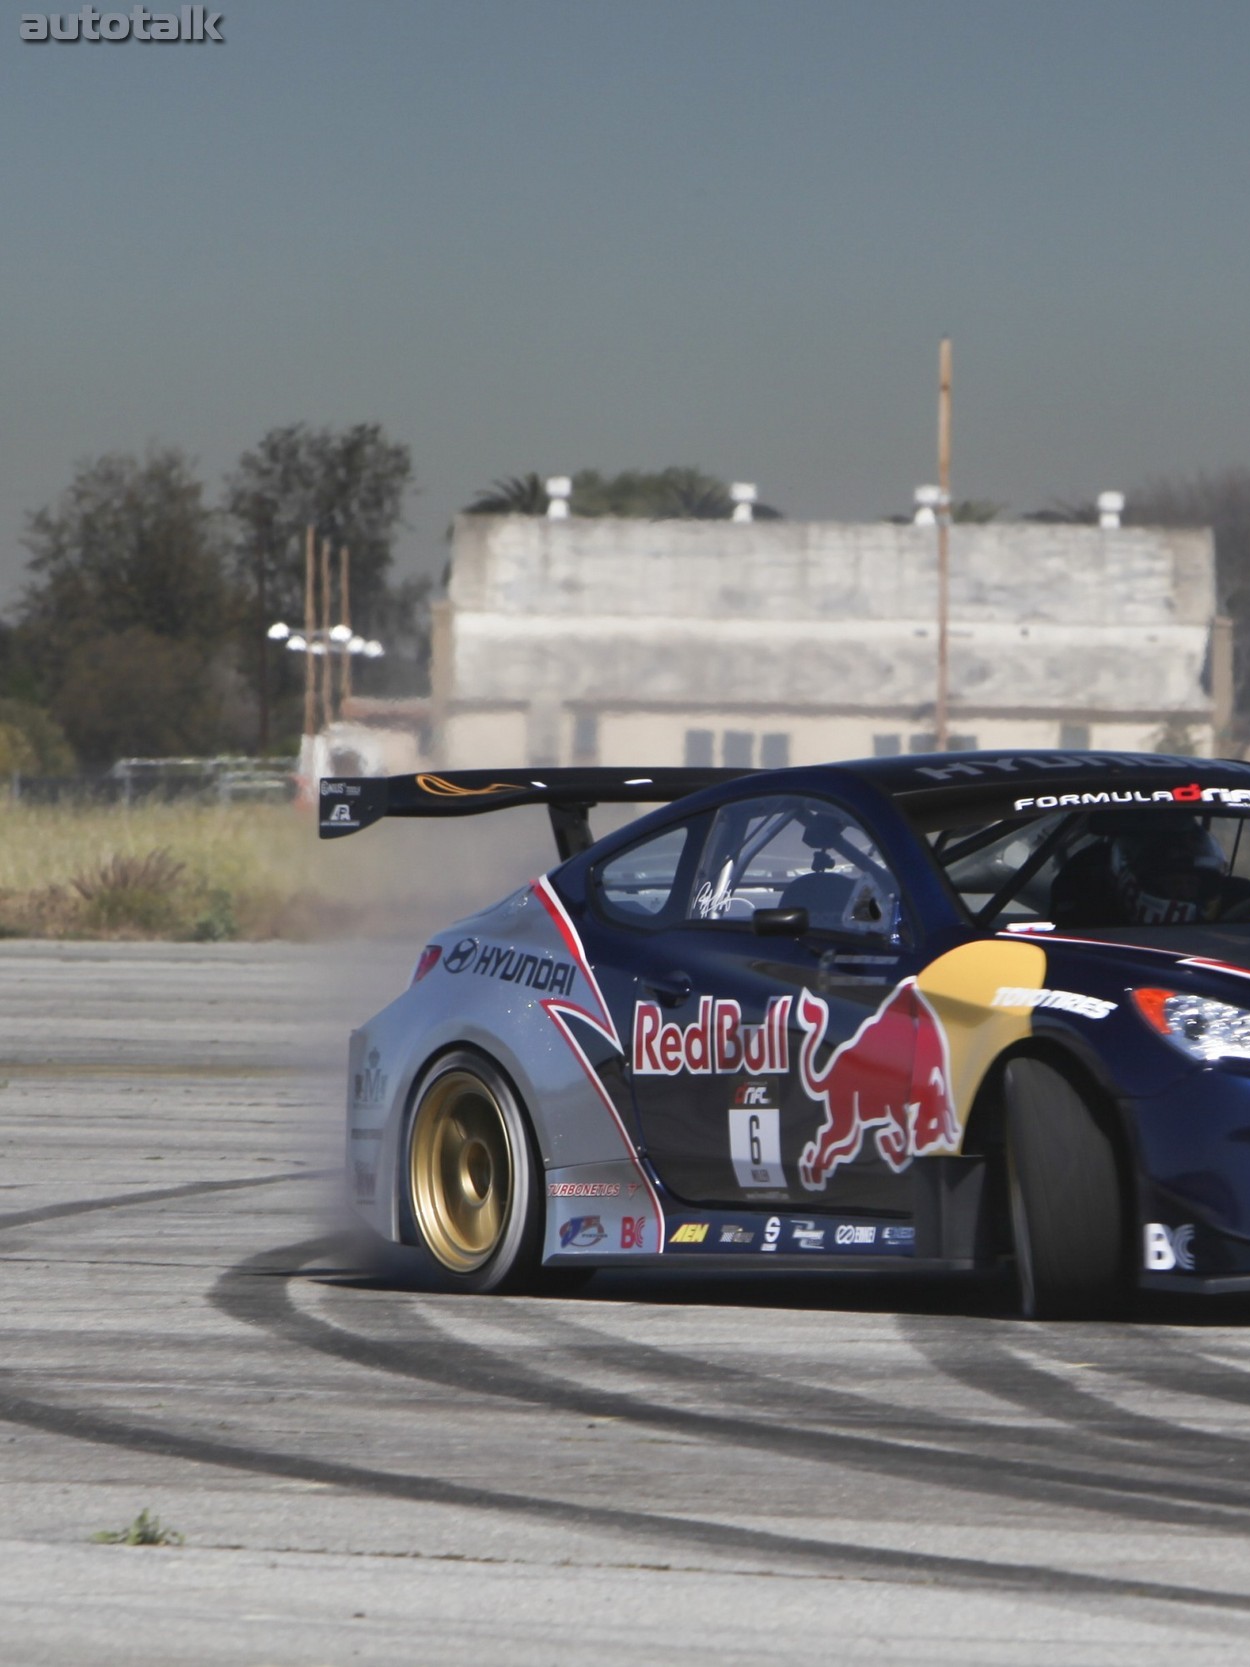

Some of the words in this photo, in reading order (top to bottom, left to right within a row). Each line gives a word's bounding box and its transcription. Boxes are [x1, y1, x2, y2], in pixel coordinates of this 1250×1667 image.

[472, 944, 578, 997] HYUNDAI
[749, 1114, 762, 1166] 6
[547, 1183, 621, 1198] TURBONETICS
